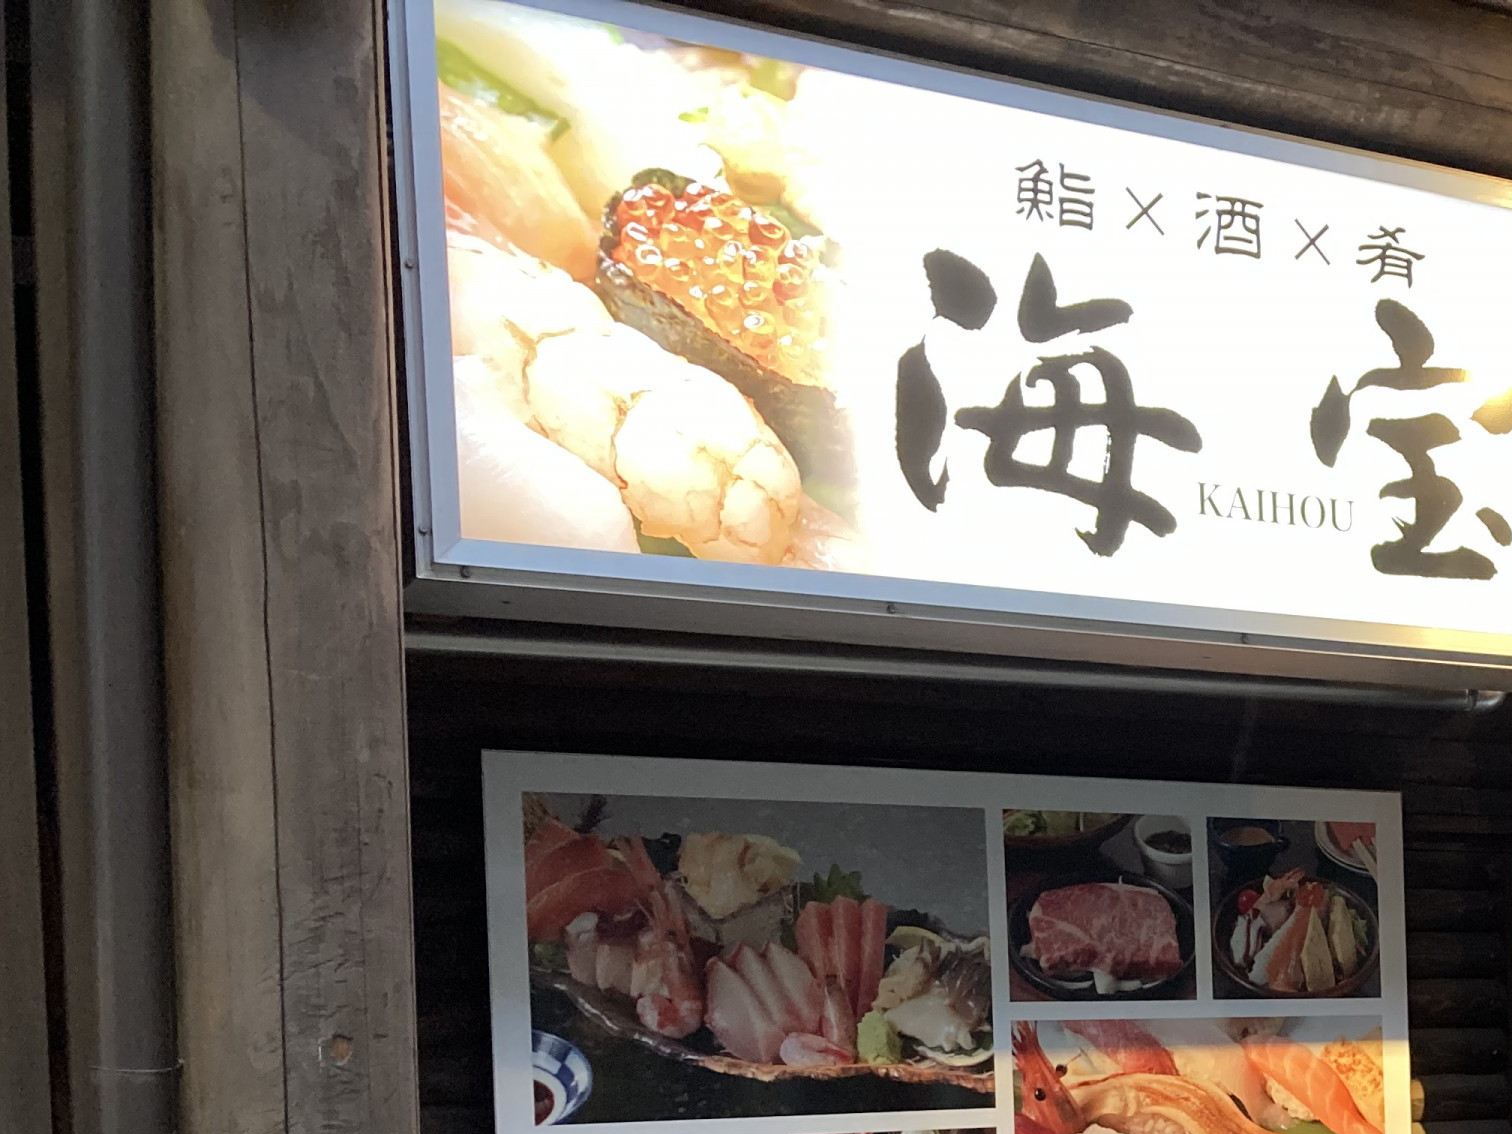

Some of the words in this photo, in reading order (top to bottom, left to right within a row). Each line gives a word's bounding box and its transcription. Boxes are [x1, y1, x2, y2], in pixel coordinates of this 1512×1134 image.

[1015, 158, 1425, 288] 鮨×酒×肴
[1197, 480, 1355, 533] KAIHOU
